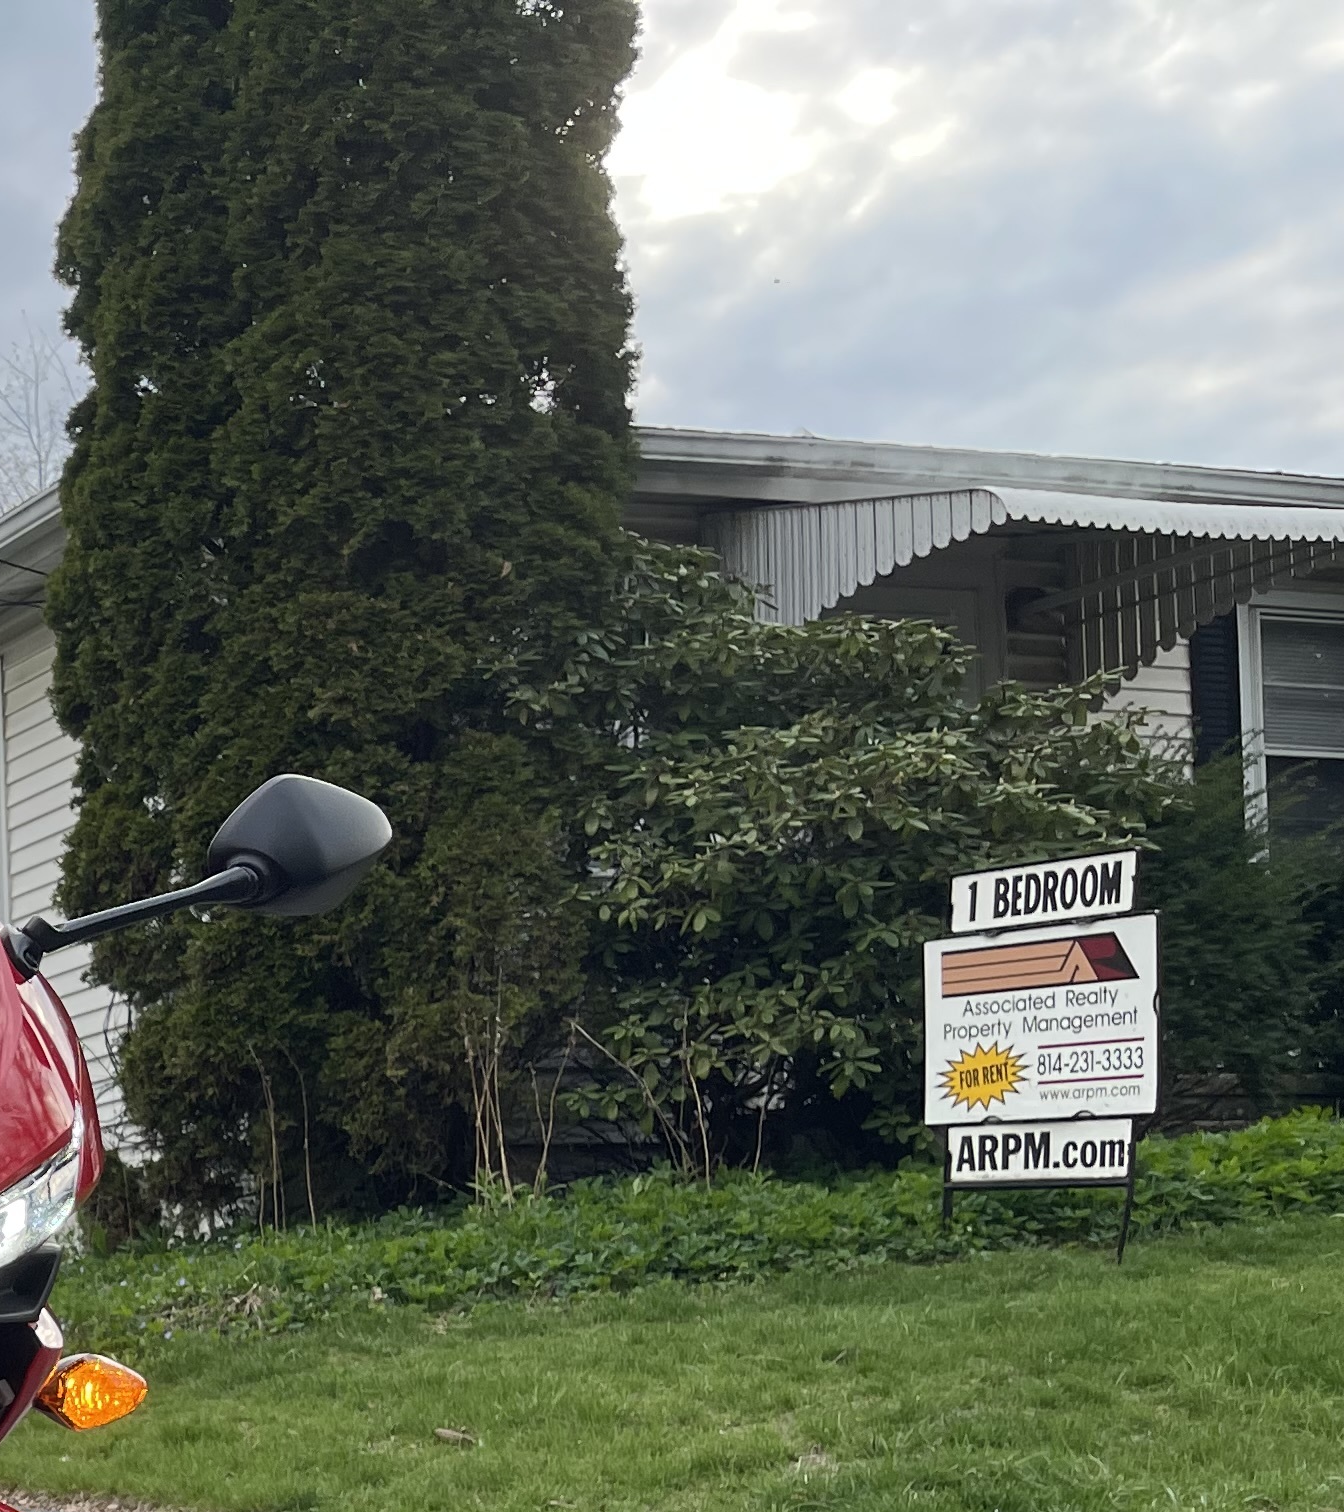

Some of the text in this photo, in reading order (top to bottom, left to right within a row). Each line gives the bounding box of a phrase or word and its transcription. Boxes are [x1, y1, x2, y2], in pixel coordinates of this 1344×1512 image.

[968, 860, 1123, 922] 1 BEDROOM
[962, 986, 1118, 1017] Associated Realty
[943, 1007, 1138, 1042] Property Management
[959, 1062, 1010, 1090] FOR RENT
[1037, 1046, 1144, 1076] 814-231-3333
[1039, 1084, 1141, 1101] www.arpm.com
[956, 1131, 1125, 1172] ARPM.com
